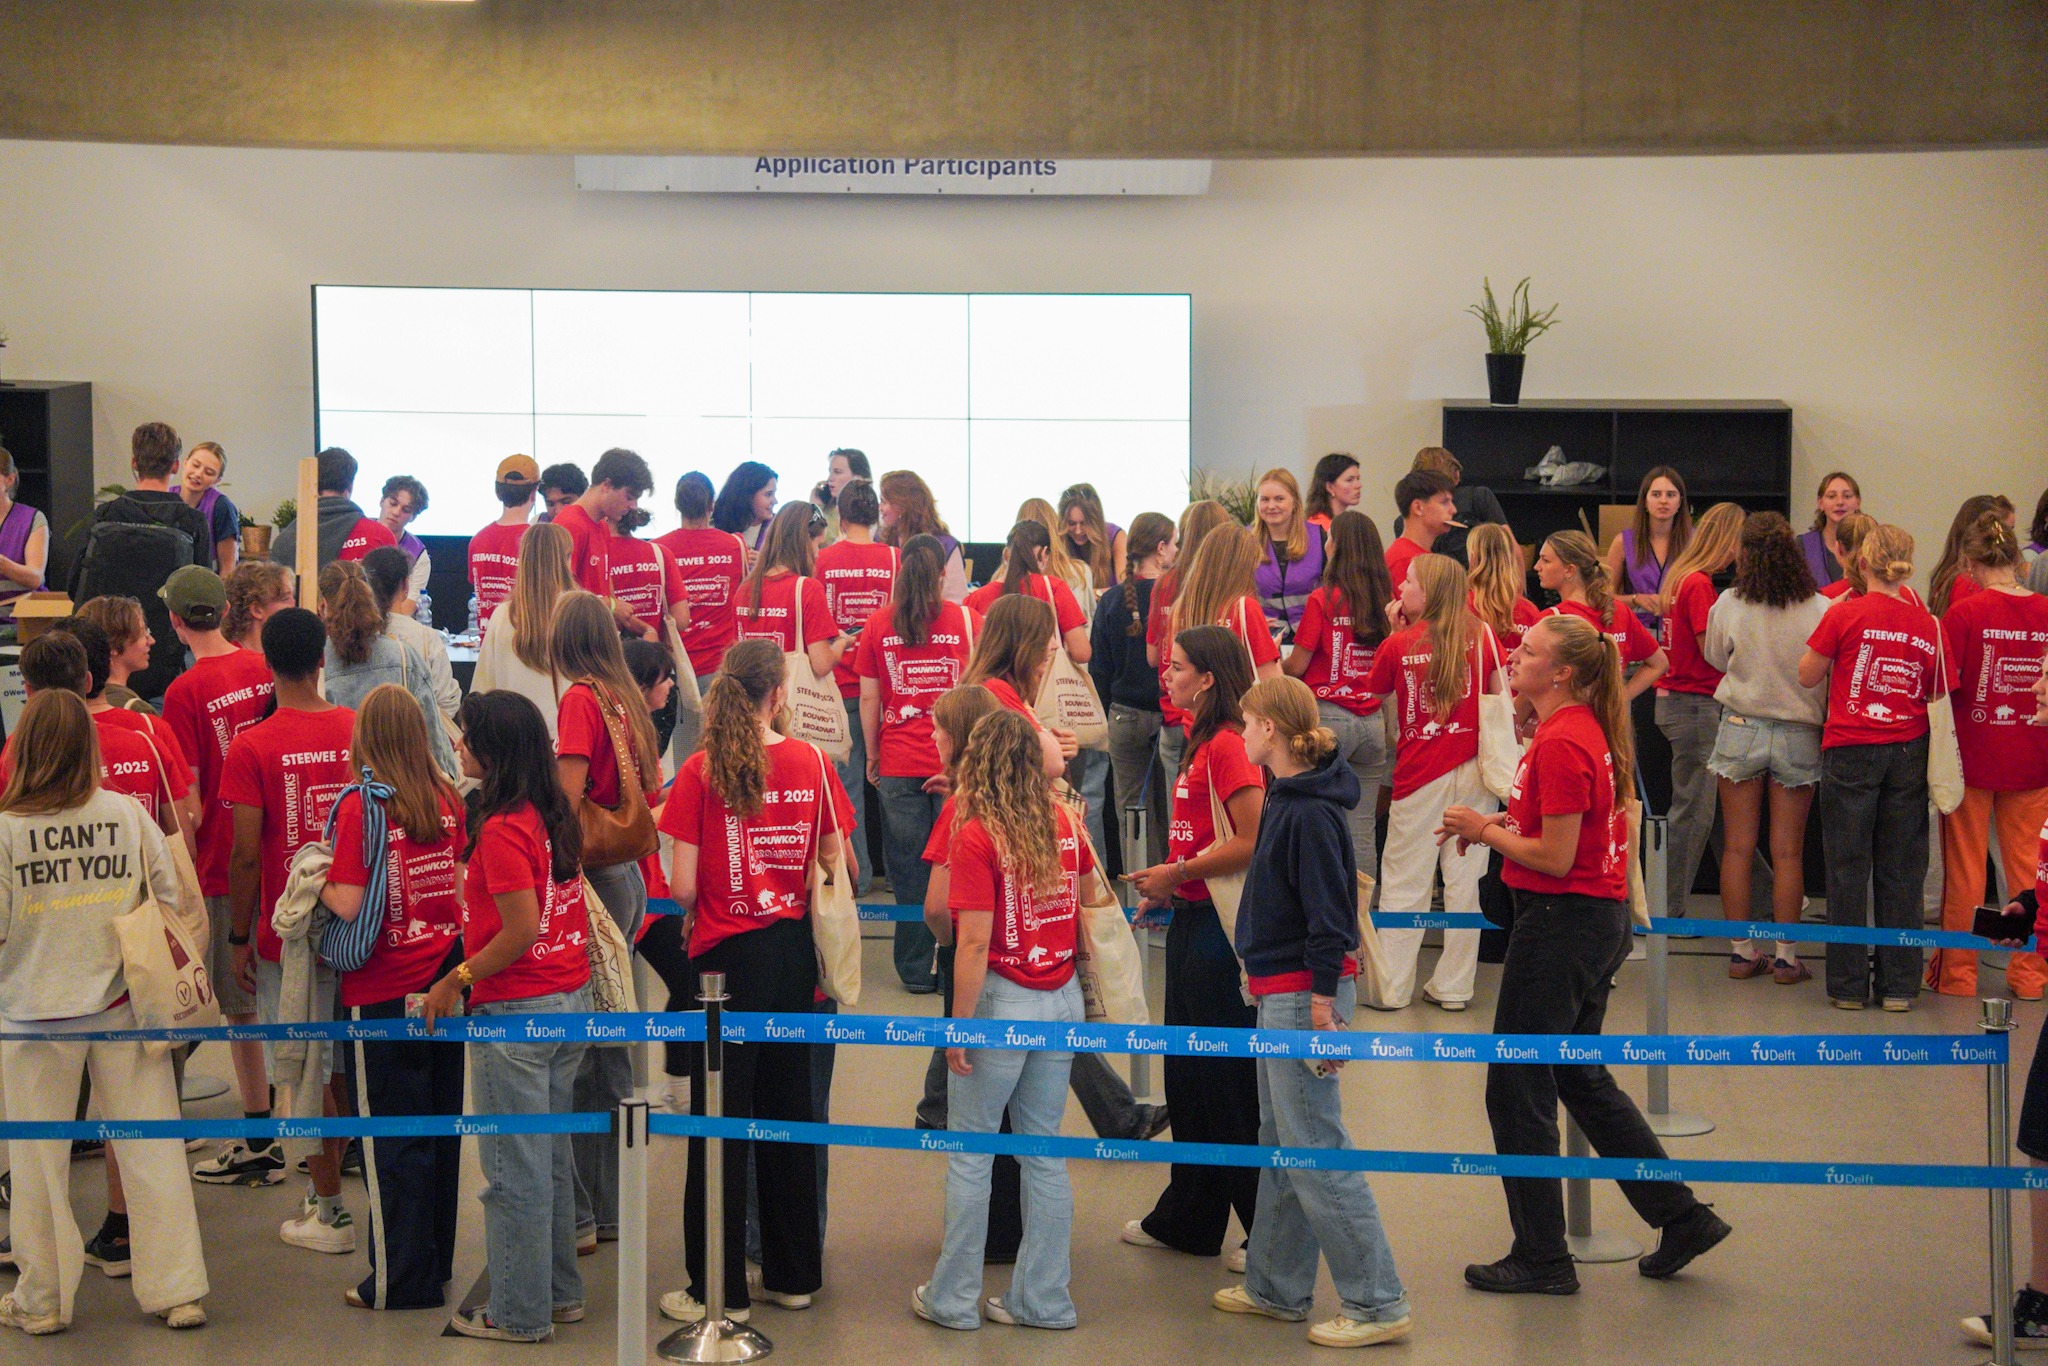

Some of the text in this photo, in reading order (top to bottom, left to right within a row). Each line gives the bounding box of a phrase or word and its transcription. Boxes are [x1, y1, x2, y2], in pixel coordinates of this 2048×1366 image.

[755, 157, 1058, 180] Application Participants
[636, 562, 660, 572] 2025
[676, 555, 733, 567] EWEE 2025
[825, 568, 891, 579] STEEWEE 2025
[932, 633, 960, 645] 2025
[1863, 629, 1936, 656] STEEWEE 2025
[1983, 629, 2048, 642] STEEWEE 202
[907, 665, 949, 675] BOUWKO'S
[1849, 642, 1871, 699] VECTORWORKS
[1976, 642, 1992, 702] VECTORWORKS
[2003, 664, 2041, 673] BOUWKO
[207, 682, 275, 713] STEEWEE 20
[281, 750, 337, 767] STEEWEE
[113, 760, 150, 776] 2025
[783, 789, 815, 803] 2025
[284, 772, 299, 847] VECTORWORKS
[29, 822, 119, 853] I CAN'T
[753, 834, 805, 846] BOUWKO'S
[1060, 837, 1076, 851] 25
[725, 814, 744, 893] VECTORWORKS
[15, 854, 132, 888] TEXT YOU.
[408, 858, 455, 877] BOUWKO'S
[387, 849, 403, 923] VECTORWORKS
[859, 910, 889, 920] UDelft
[1004, 874, 1020, 950] VECTORWORKS
[722, 1024, 746, 1037] Delft
